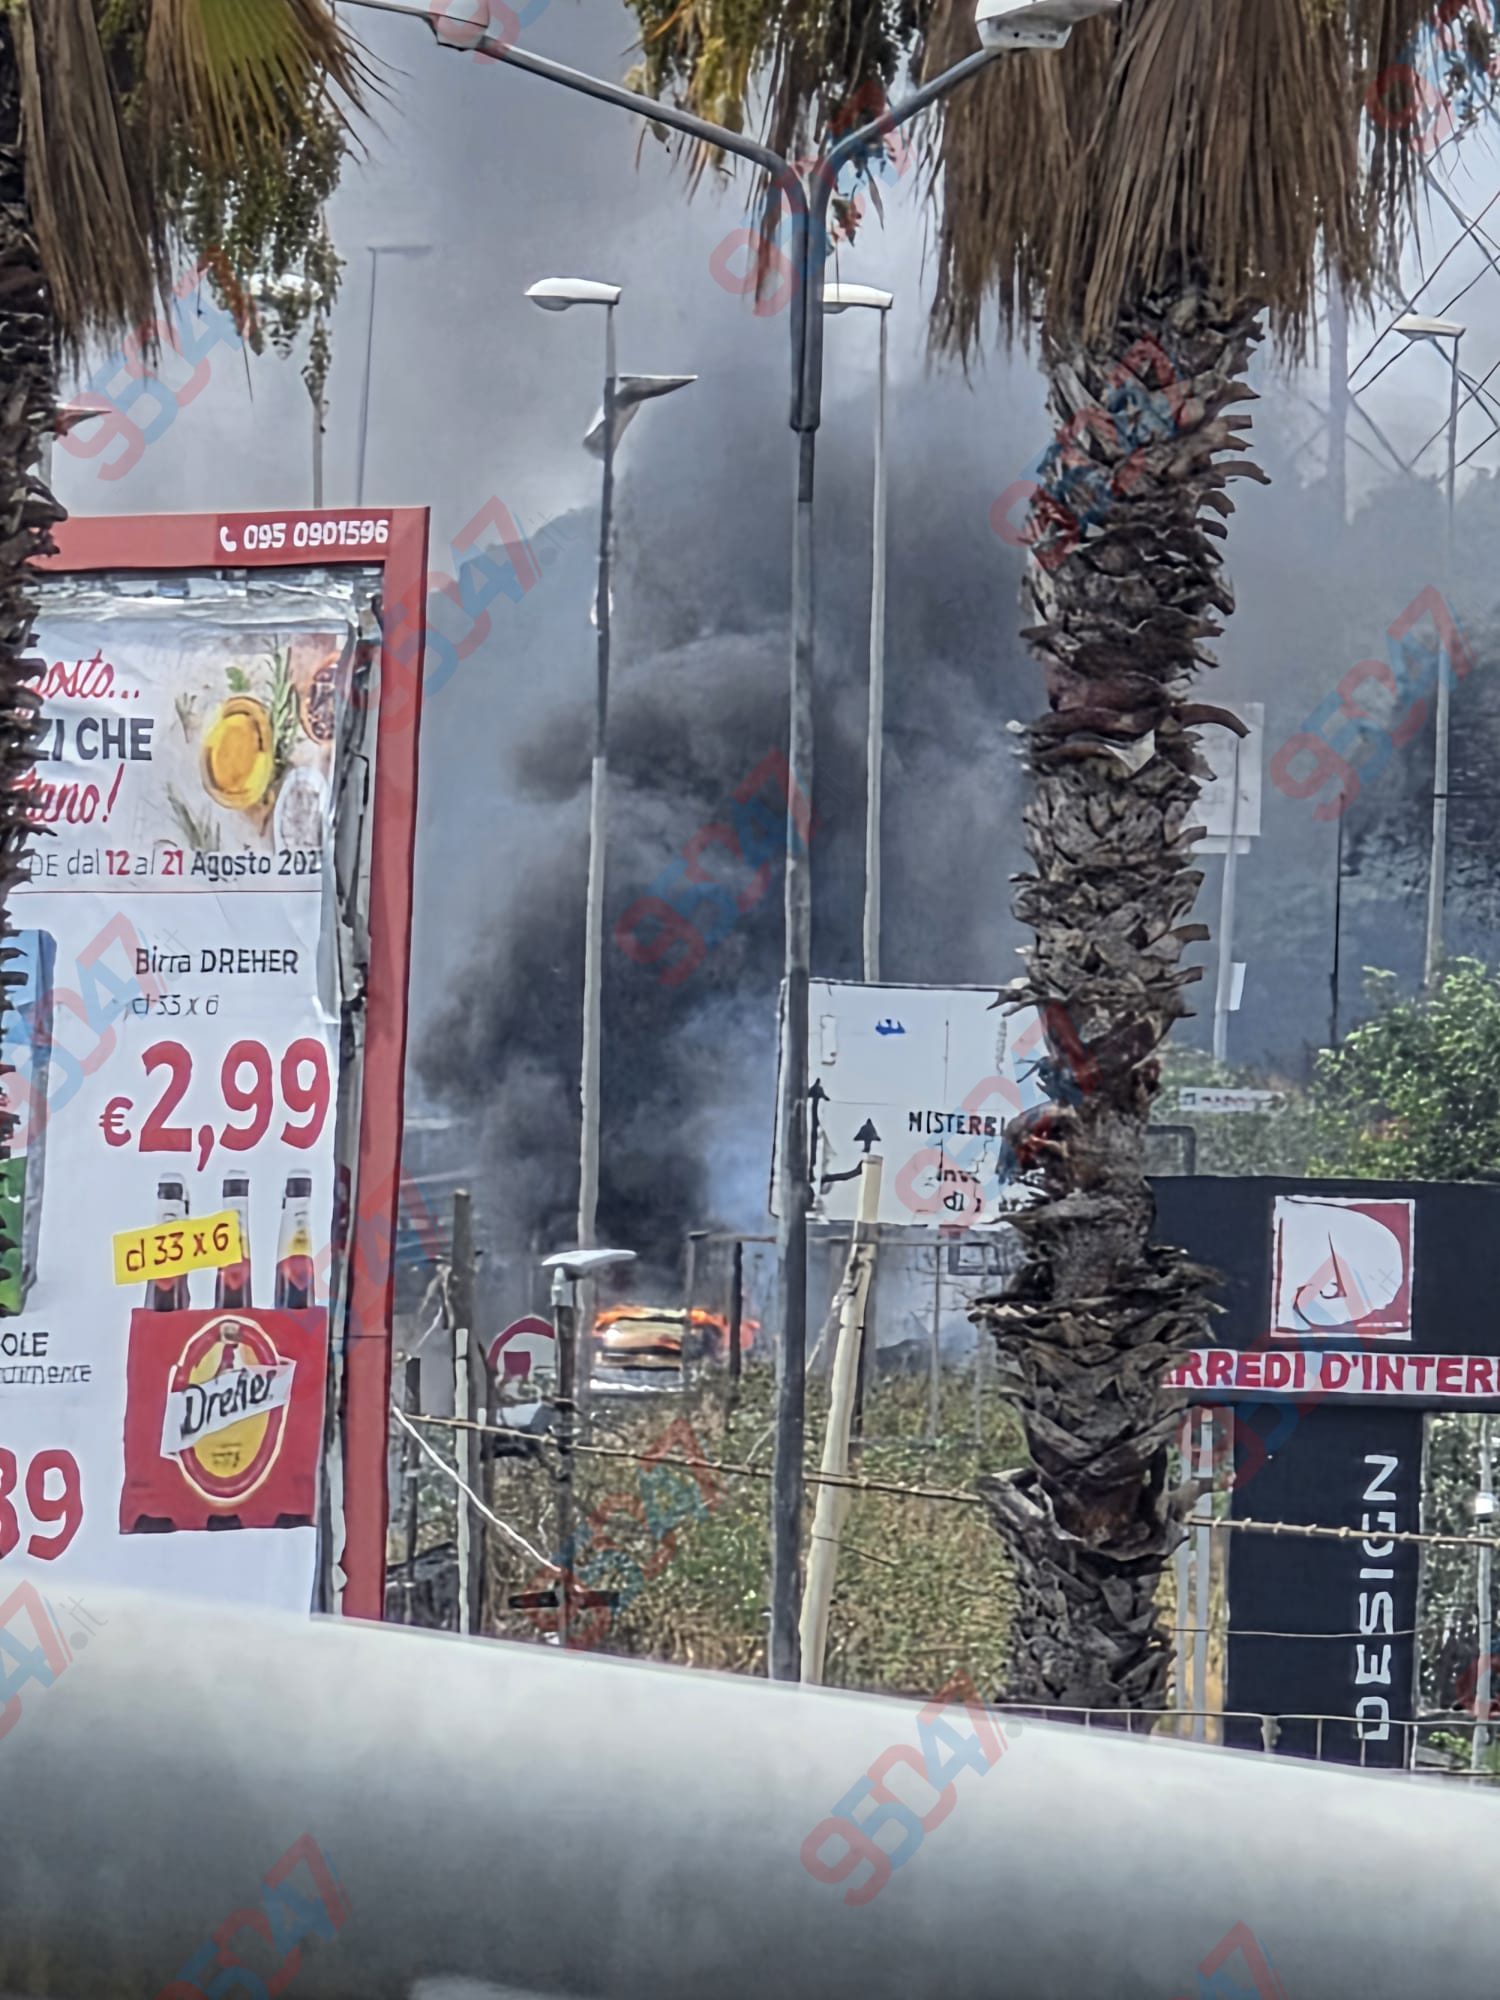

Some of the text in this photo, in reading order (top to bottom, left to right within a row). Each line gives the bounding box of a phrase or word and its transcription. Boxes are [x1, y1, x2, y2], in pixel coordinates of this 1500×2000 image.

[243, 519, 389, 549] 095 0901596
[76, 717, 154, 761] CHE
[29, 852, 59, 877] DE
[67, 848, 99, 875] dal
[105, 850, 130, 875] 12
[161, 850, 183, 876] 21
[191, 850, 271, 882] Agosto
[278, 849, 322, 876] 202
[136, 946, 298, 975] Birra DREHER
[139, 1038, 330, 1172] 2,99
[153, 1231, 184, 1265] 33
[192, 1232, 207, 1257] x
[213, 1222, 229, 1251] 6
[1160, 1351, 1500, 1394] RREDI D'INTER
[1354, 1454, 1399, 1741] DESIGN
